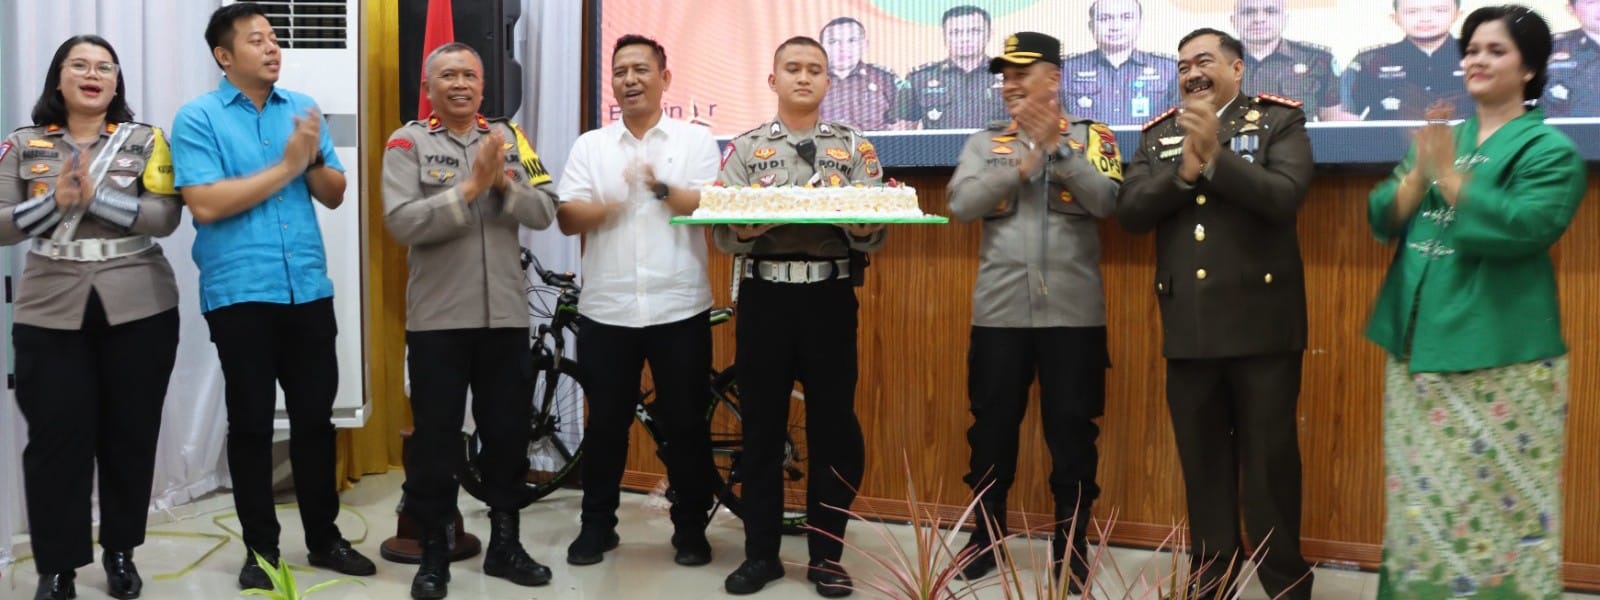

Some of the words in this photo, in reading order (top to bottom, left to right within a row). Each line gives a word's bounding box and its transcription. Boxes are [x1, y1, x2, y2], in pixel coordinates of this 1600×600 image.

[424, 154, 460, 168] YUDI
[748, 159, 785, 174] YUDI
[818, 159, 852, 175] POLRI
